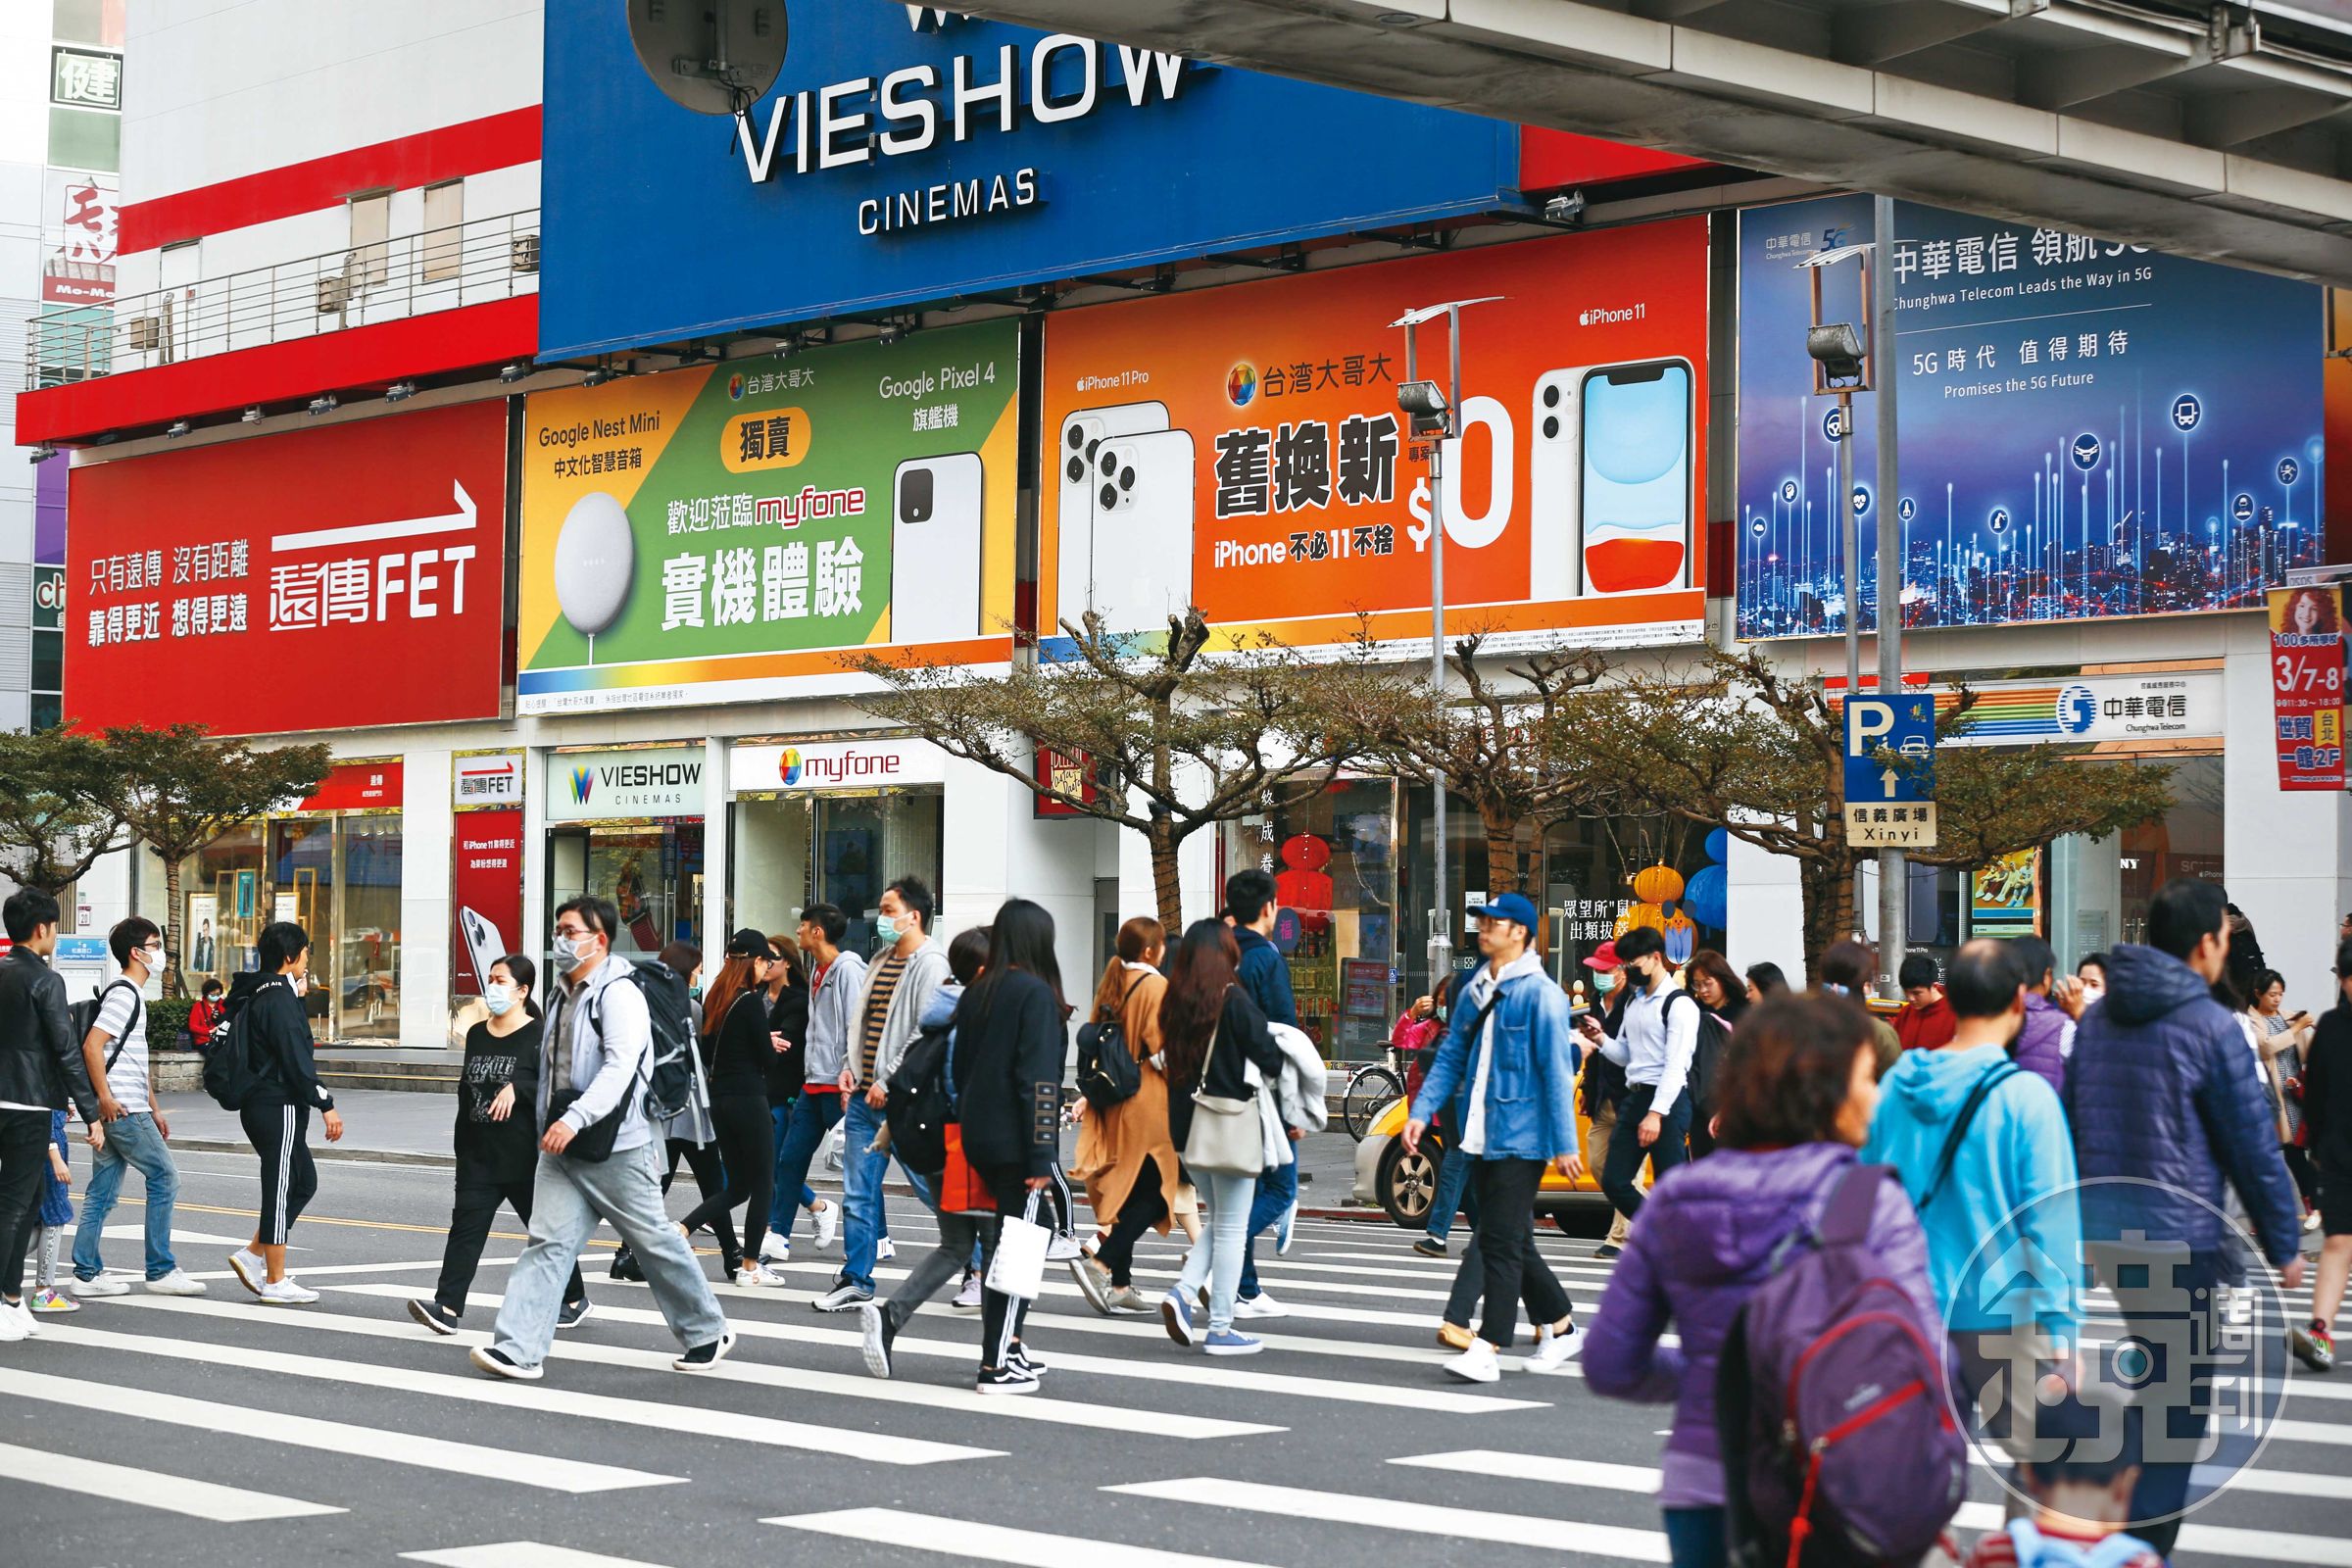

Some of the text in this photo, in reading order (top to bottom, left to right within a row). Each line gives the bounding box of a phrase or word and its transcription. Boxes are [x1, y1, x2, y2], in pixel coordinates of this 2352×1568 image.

[60, 57, 118, 99] 健
[735, 33, 1182, 183] VIESHOW
[858, 168, 1037, 235] CINEMAS
[1766, 231, 1812, 250] 中華電信
[1893, 227, 2098, 284] 中華電信 領航
[1960, 284, 2015, 302] Telecom
[2019, 278, 2056, 294] Leads
[2061, 274, 2082, 290] the
[2086, 271, 2113, 287] Way
[2118, 270, 2131, 283] in
[2134, 267, 2152, 281] 5G
[1590, 303, 1645, 325] iPhone 11
[2019, 329, 2129, 366] 值得期待
[879, 362, 996, 401] Google Pixel 4
[1085, 370, 1150, 391] iPhone 11 Pro
[1944, 371, 2094, 399] Promises the 5G Future
[539, 410, 660, 448] Google Nest Mini
[912, 404, 958, 432] 旗艦機
[740, 416, 791, 463] 獨賣
[554, 447, 642, 478] 中文化智慧音箱
[1214, 412, 1399, 518] 舊換新
[667, 485, 865, 536] 歡迎蒞臨 myfone
[89, 539, 249, 596] 只有遠傳 沒有距離
[1214, 540, 1287, 568] iPhone
[661, 536, 864, 631] 實機體驗
[88, 592, 248, 647] 靠得更近 想得更遠
[2276, 655, 2340, 692] 3/7-8
[2103, 695, 2186, 719] 中華電信
[1848, 702, 1894, 757] P
[2126, 723, 2159, 733] Chunghwa
[2278, 715, 2313, 740] 世貿
[2321, 712, 2335, 742] 台北
[600, 763, 702, 787] VIESHOW
[806, 751, 900, 782] myfone
[615, 793, 682, 807] CINEMAS
[1853, 808, 1928, 823] 信義廣場
[1864, 827, 1919, 843] Xinyi
[1280, 919, 1293, 941] 福
[256, 982, 270, 993] NIKE
